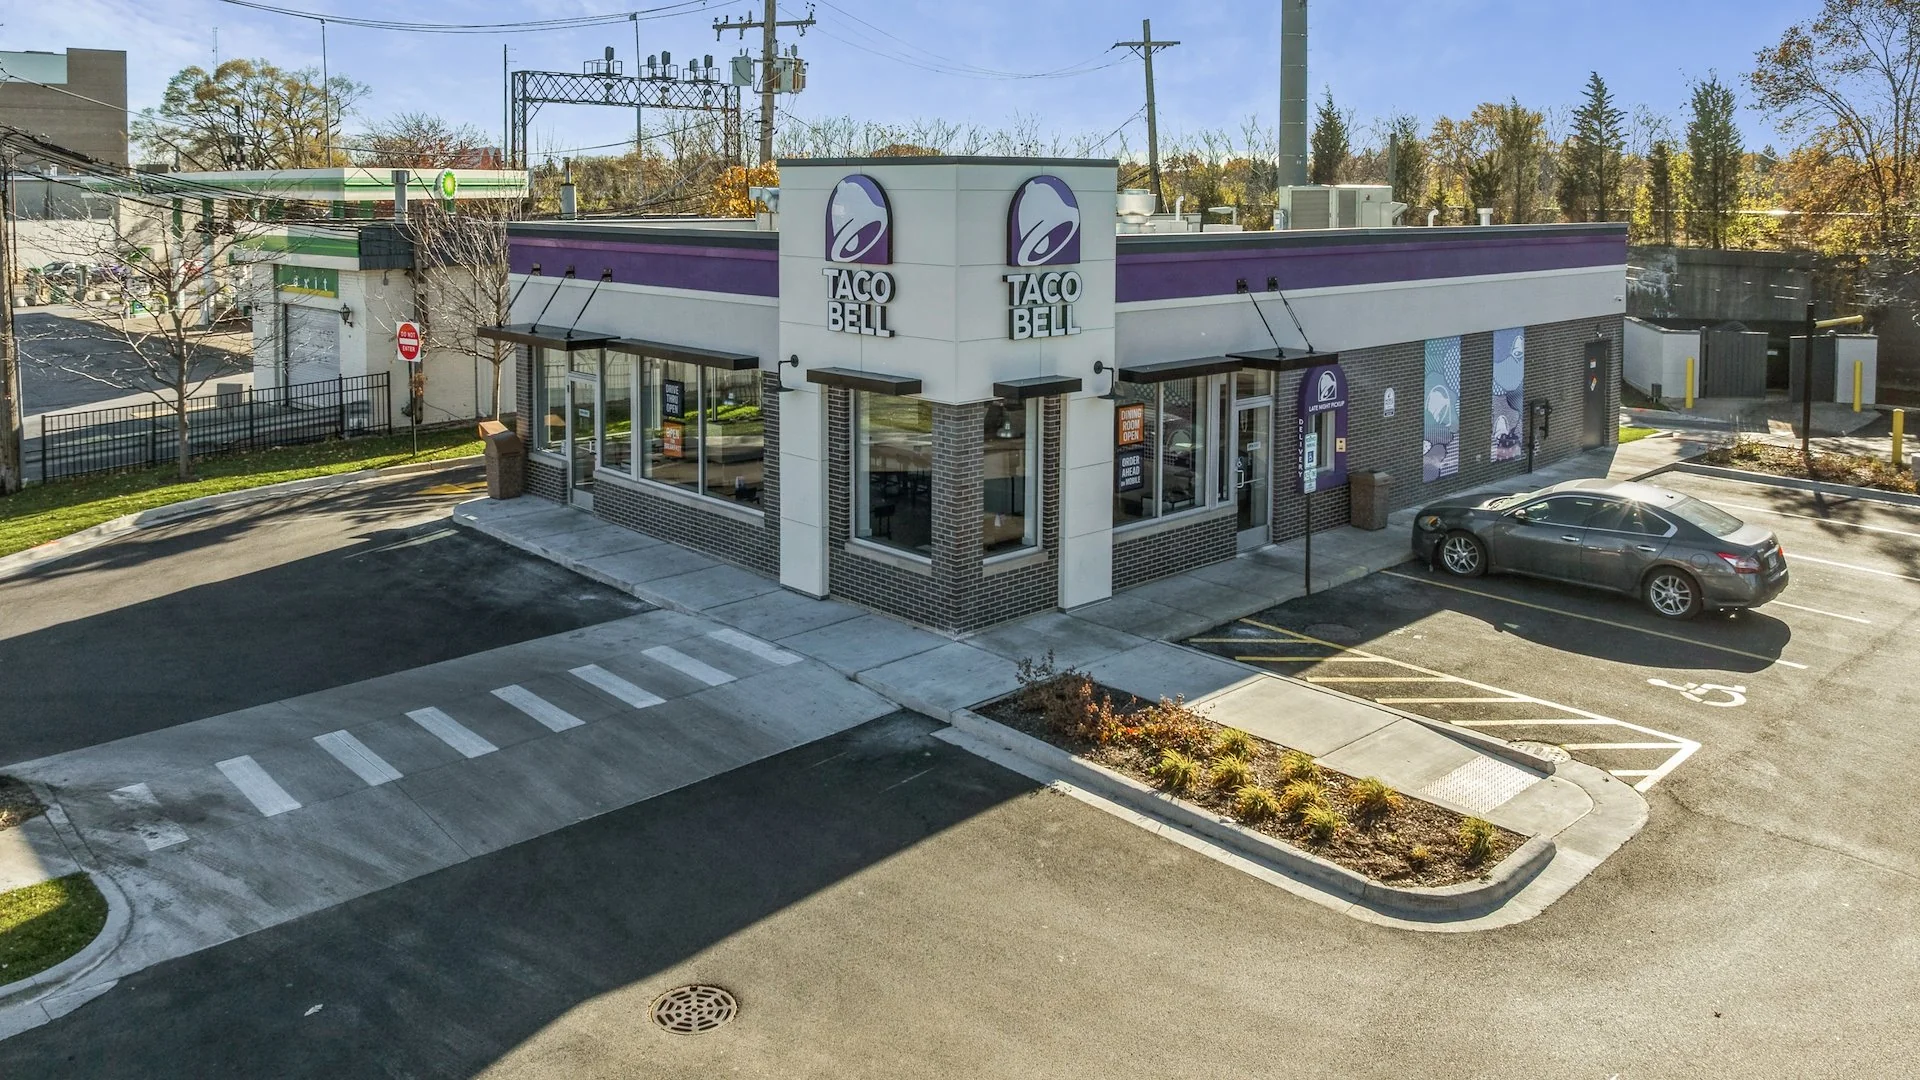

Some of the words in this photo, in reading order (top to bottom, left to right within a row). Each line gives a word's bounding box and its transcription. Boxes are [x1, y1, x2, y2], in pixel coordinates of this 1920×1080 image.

[822, 268, 896, 303] TACO
[1003, 271, 1082, 306] TACO
[827, 301, 895, 338] BELL
[1009, 305, 1082, 340] BELL
[665, 384, 679, 394] DRIVE
[666, 393, 679, 404] THRU
[666, 402, 679, 413] OPEN
[1318, 402, 1330, 410] NIGHT
[1330, 400, 1345, 409] PICKUP
[1121, 408, 1142, 420] DINING
[1122, 419, 1140, 431] ROOM
[1123, 431, 1139, 442] OPEN
[1122, 455, 1140, 467] ORDER
[1122, 466, 1140, 478] AHEAD
[1126, 476, 1141, 485] MOBILE
